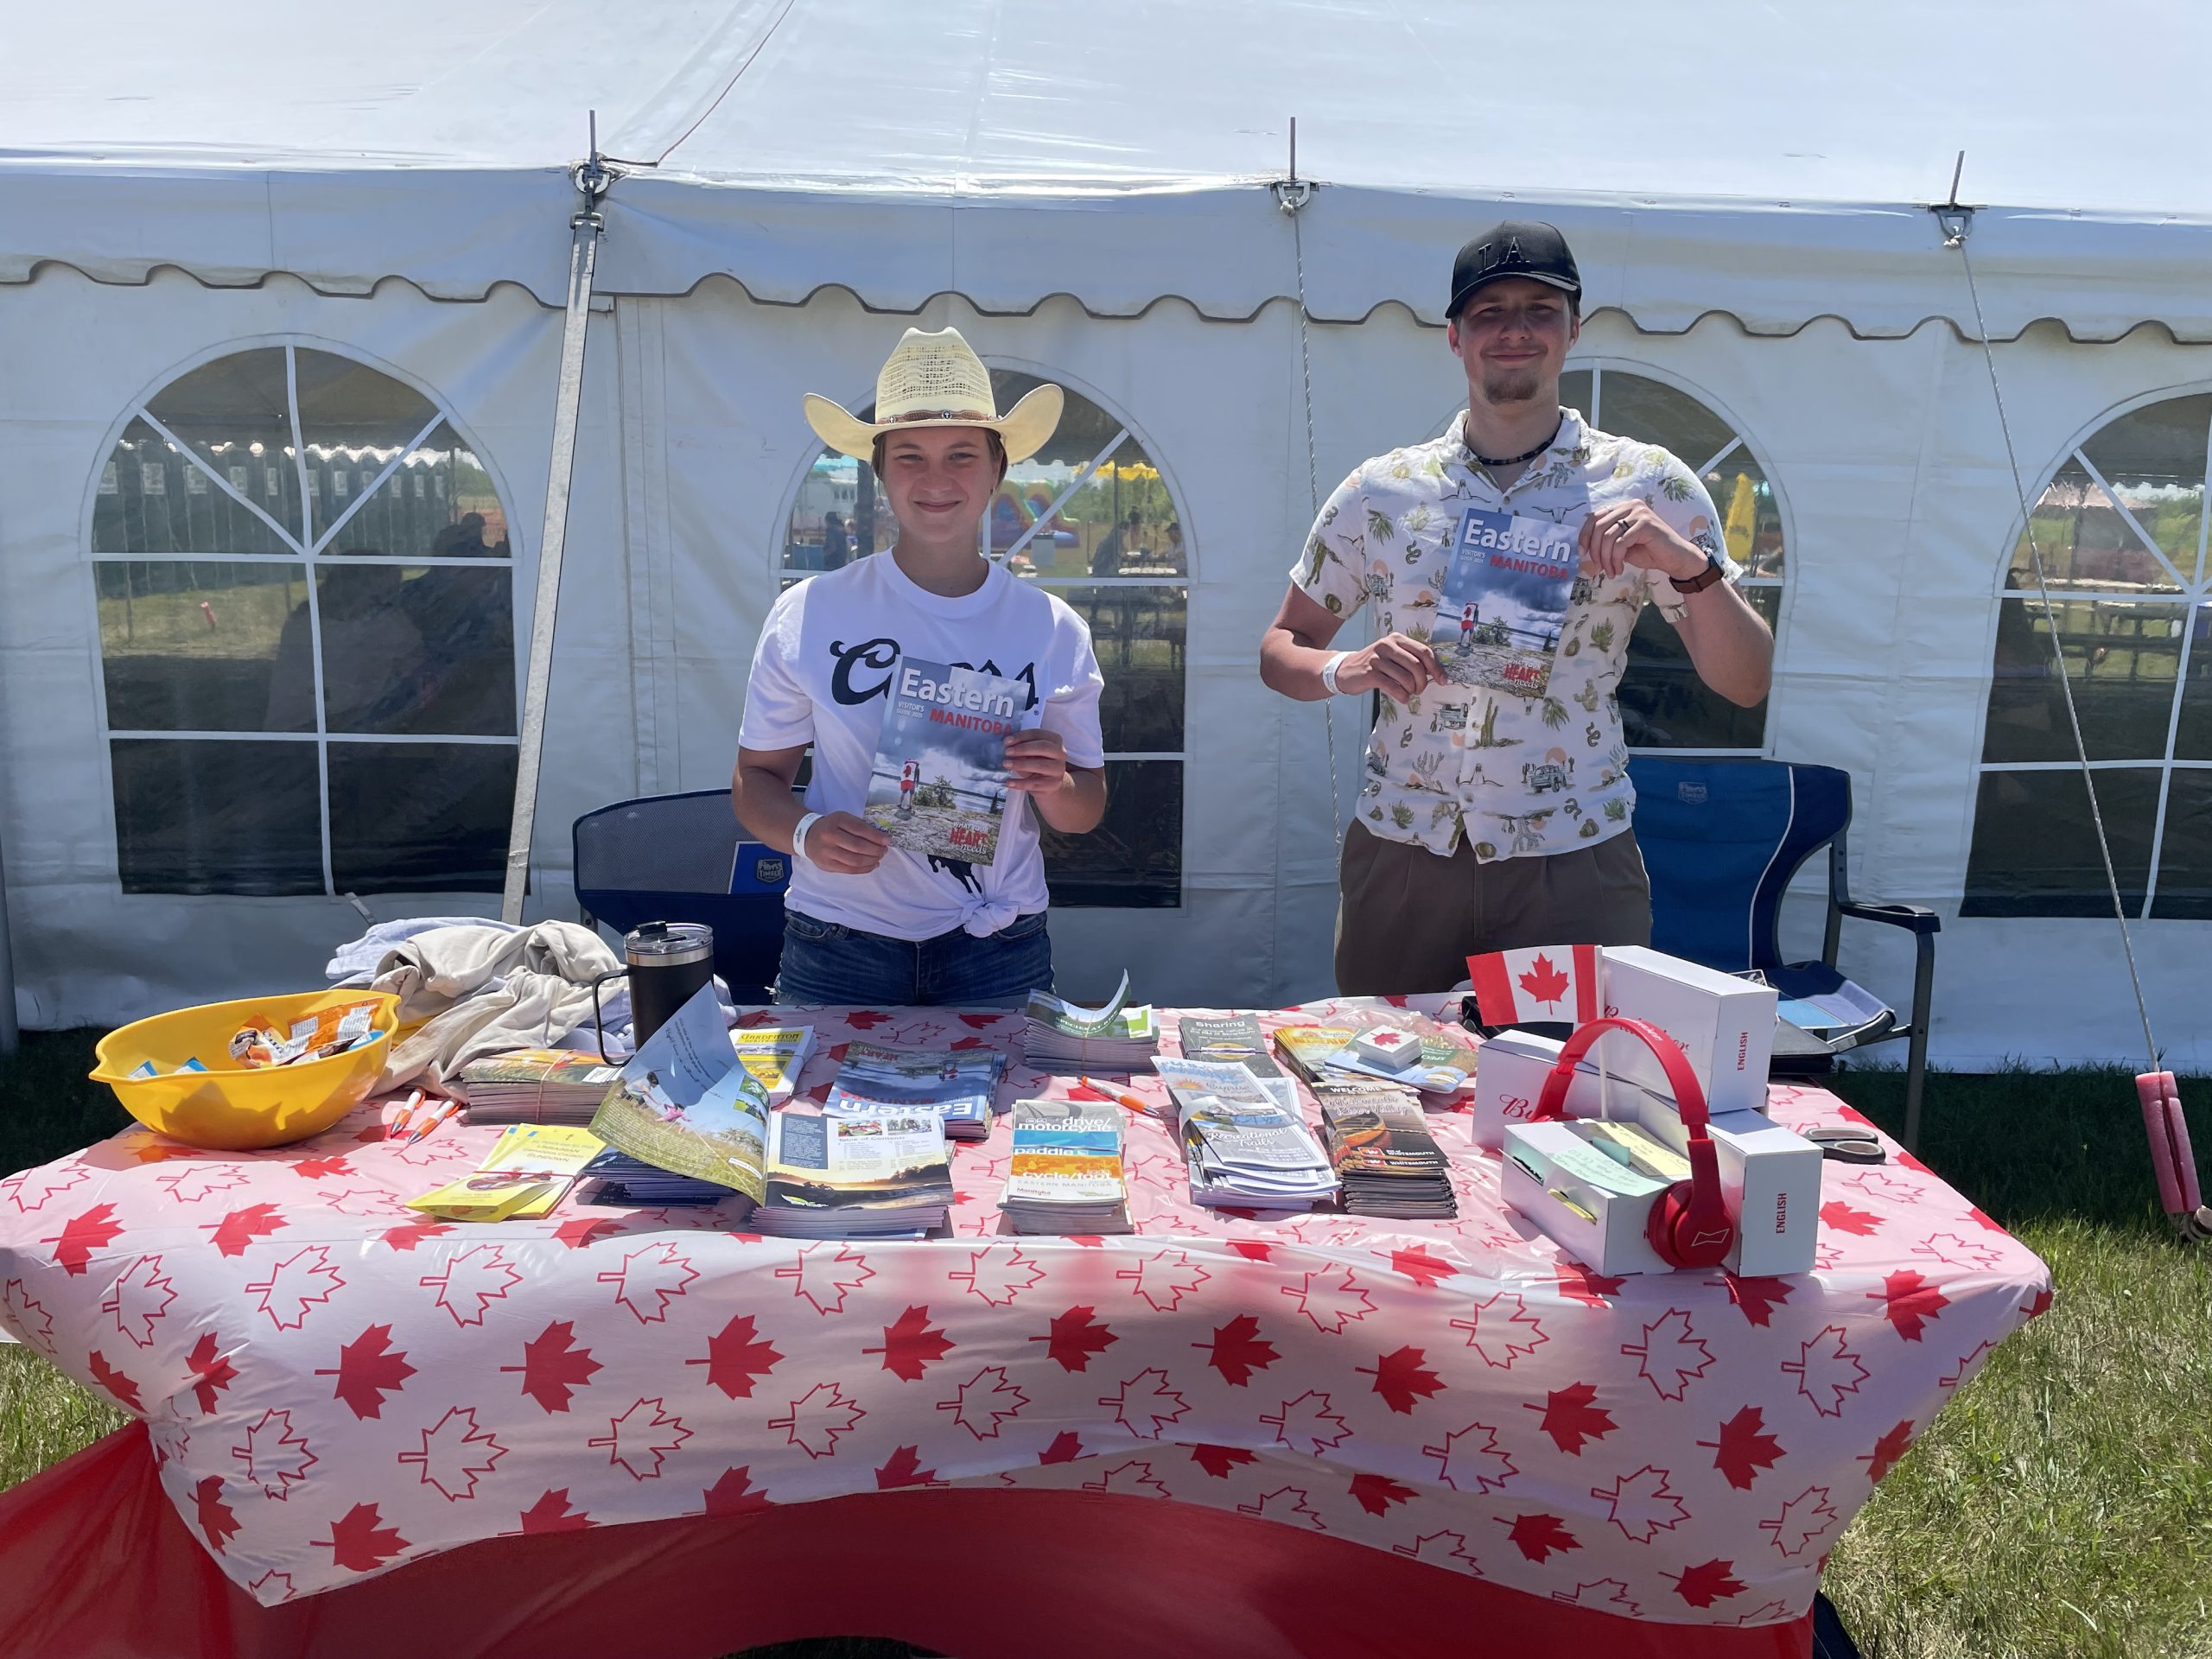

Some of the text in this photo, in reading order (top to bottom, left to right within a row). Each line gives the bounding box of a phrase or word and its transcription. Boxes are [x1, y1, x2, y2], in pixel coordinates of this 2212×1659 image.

[1464, 518, 1571, 562] Eastern
[1490, 553, 1569, 580] MANITOBA
[1503, 664, 1541, 681] HEART
[1514, 678, 1539, 689] needs
[900, 668, 1014, 718] Eastern
[898, 701, 925, 713] VISITOR'S
[929, 708, 1012, 734] MANITOBA
[949, 827, 988, 846] HEART
[960, 843, 987, 855] needs
[1737, 1032, 1748, 1071] ENGLISH
[839, 1099, 973, 1116] Eastern
[1018, 1122, 1112, 1133] motorcycle
[1062, 1116, 1111, 1125] drive/
[1207, 1128, 1288, 1142] Recreational
[1776, 1192, 1787, 1234] ENGLISH
